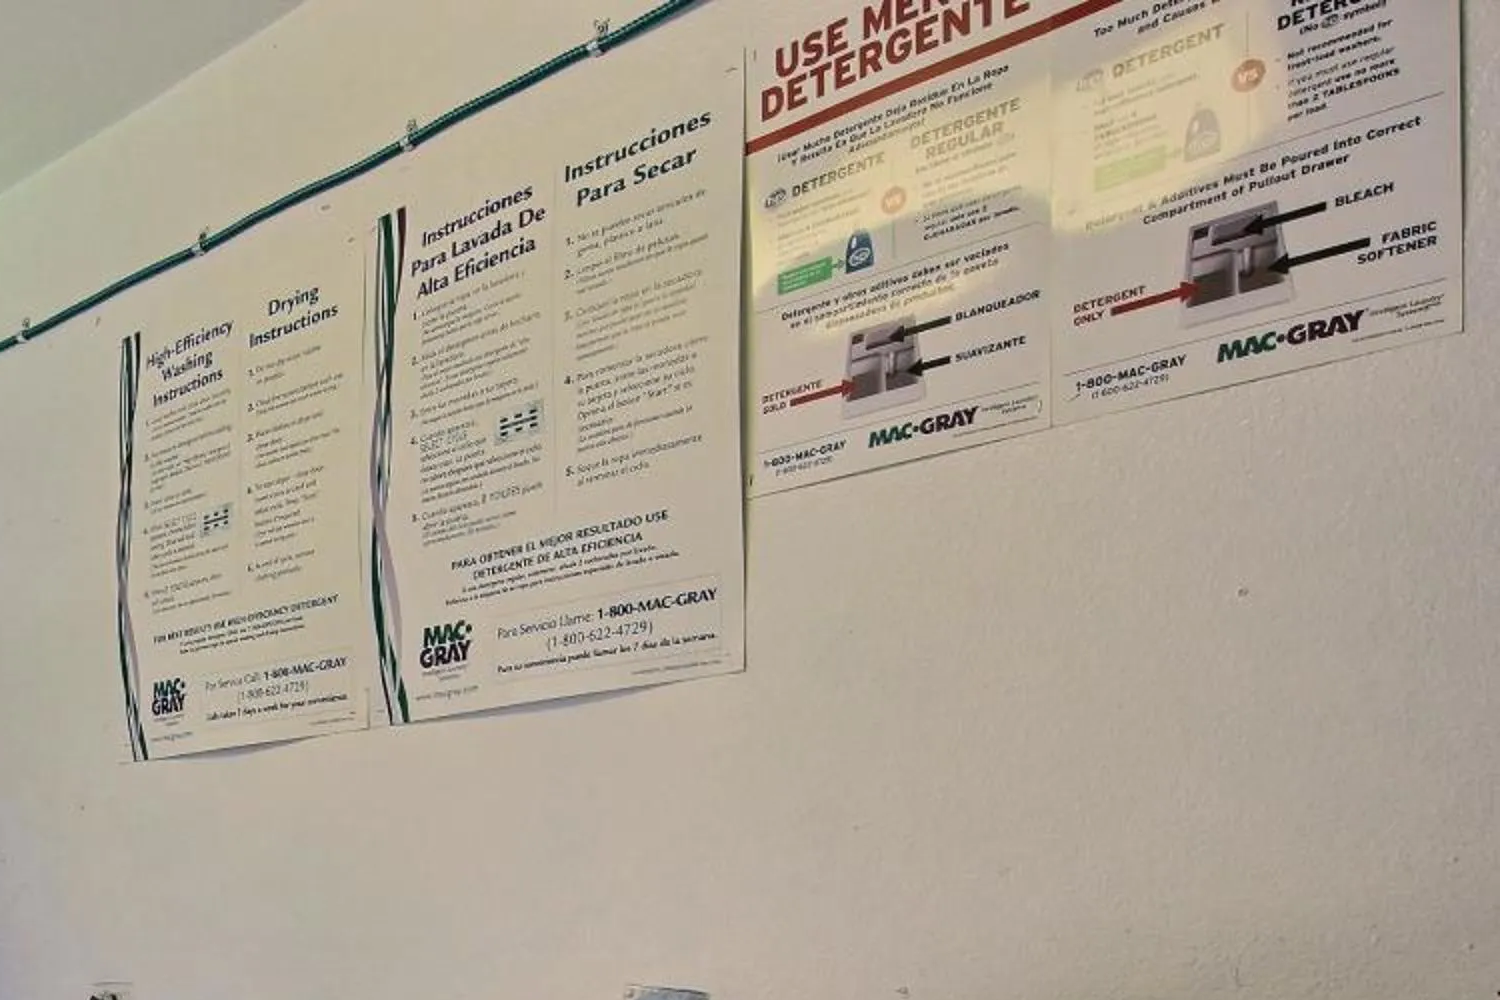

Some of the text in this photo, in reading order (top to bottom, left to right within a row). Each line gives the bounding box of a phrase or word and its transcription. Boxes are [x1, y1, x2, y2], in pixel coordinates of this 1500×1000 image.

[1094, 10, 1149, 38] Too Much
[1277, 0, 1359, 30] DETER
[775, 17, 848, 78] USE
[1112, 22, 1225, 78] DETERGENT
[833, 115, 882, 140] Detergente
[910, 97, 1021, 149] DETERGENTE
[925, 120, 1003, 160] REGULAR
[565, 112, 711, 182] Instrucciones
[1223, 166, 1255, 186] Must
[1259, 159, 1277, 174] Be
[1281, 144, 1329, 168] Poured
[1367, 116, 1422, 142] Correct
[576, 148, 697, 207] Para Secar
[791, 151, 885, 198] DETERGENTE
[1143, 191, 1228, 226] Compartment
[1231, 185, 1245, 198] of
[1301, 154, 1350, 175] Drawer
[1335, 182, 1394, 207] BLEACH
[422, 186, 533, 247] Instrucciones
[1382, 221, 1437, 244] FABRIC
[411, 208, 546, 277] Para Lavada De
[1357, 235, 1437, 265] SOFTENER
[417, 237, 536, 300] Alta Eficiencia
[268, 287, 319, 316] Drying
[955, 289, 1041, 321] BLANQUEADOR
[1073, 285, 1146, 314] DETERGENT
[1073, 310, 1106, 326] ONLY
[146, 320, 234, 369] High-Efficiency
[250, 304, 338, 348] Instructions
[161, 351, 213, 382] Washing
[955, 336, 1026, 362] SUAVIZANTE
[153, 368, 223, 408] Instructions
[1076, 354, 1186, 392] 1-800-MAC-GRAY
[451, 510, 669, 570] PARA OBTENER EL MEJOR RESULTADO USE
[473, 532, 643, 581] DETERGENTE DE ALTA EFICIENCIA
[597, 588, 718, 620] 1-800-MAC-GRAY
[420, 640, 471, 668] GRAY
[152, 694, 185, 716] GRAY
